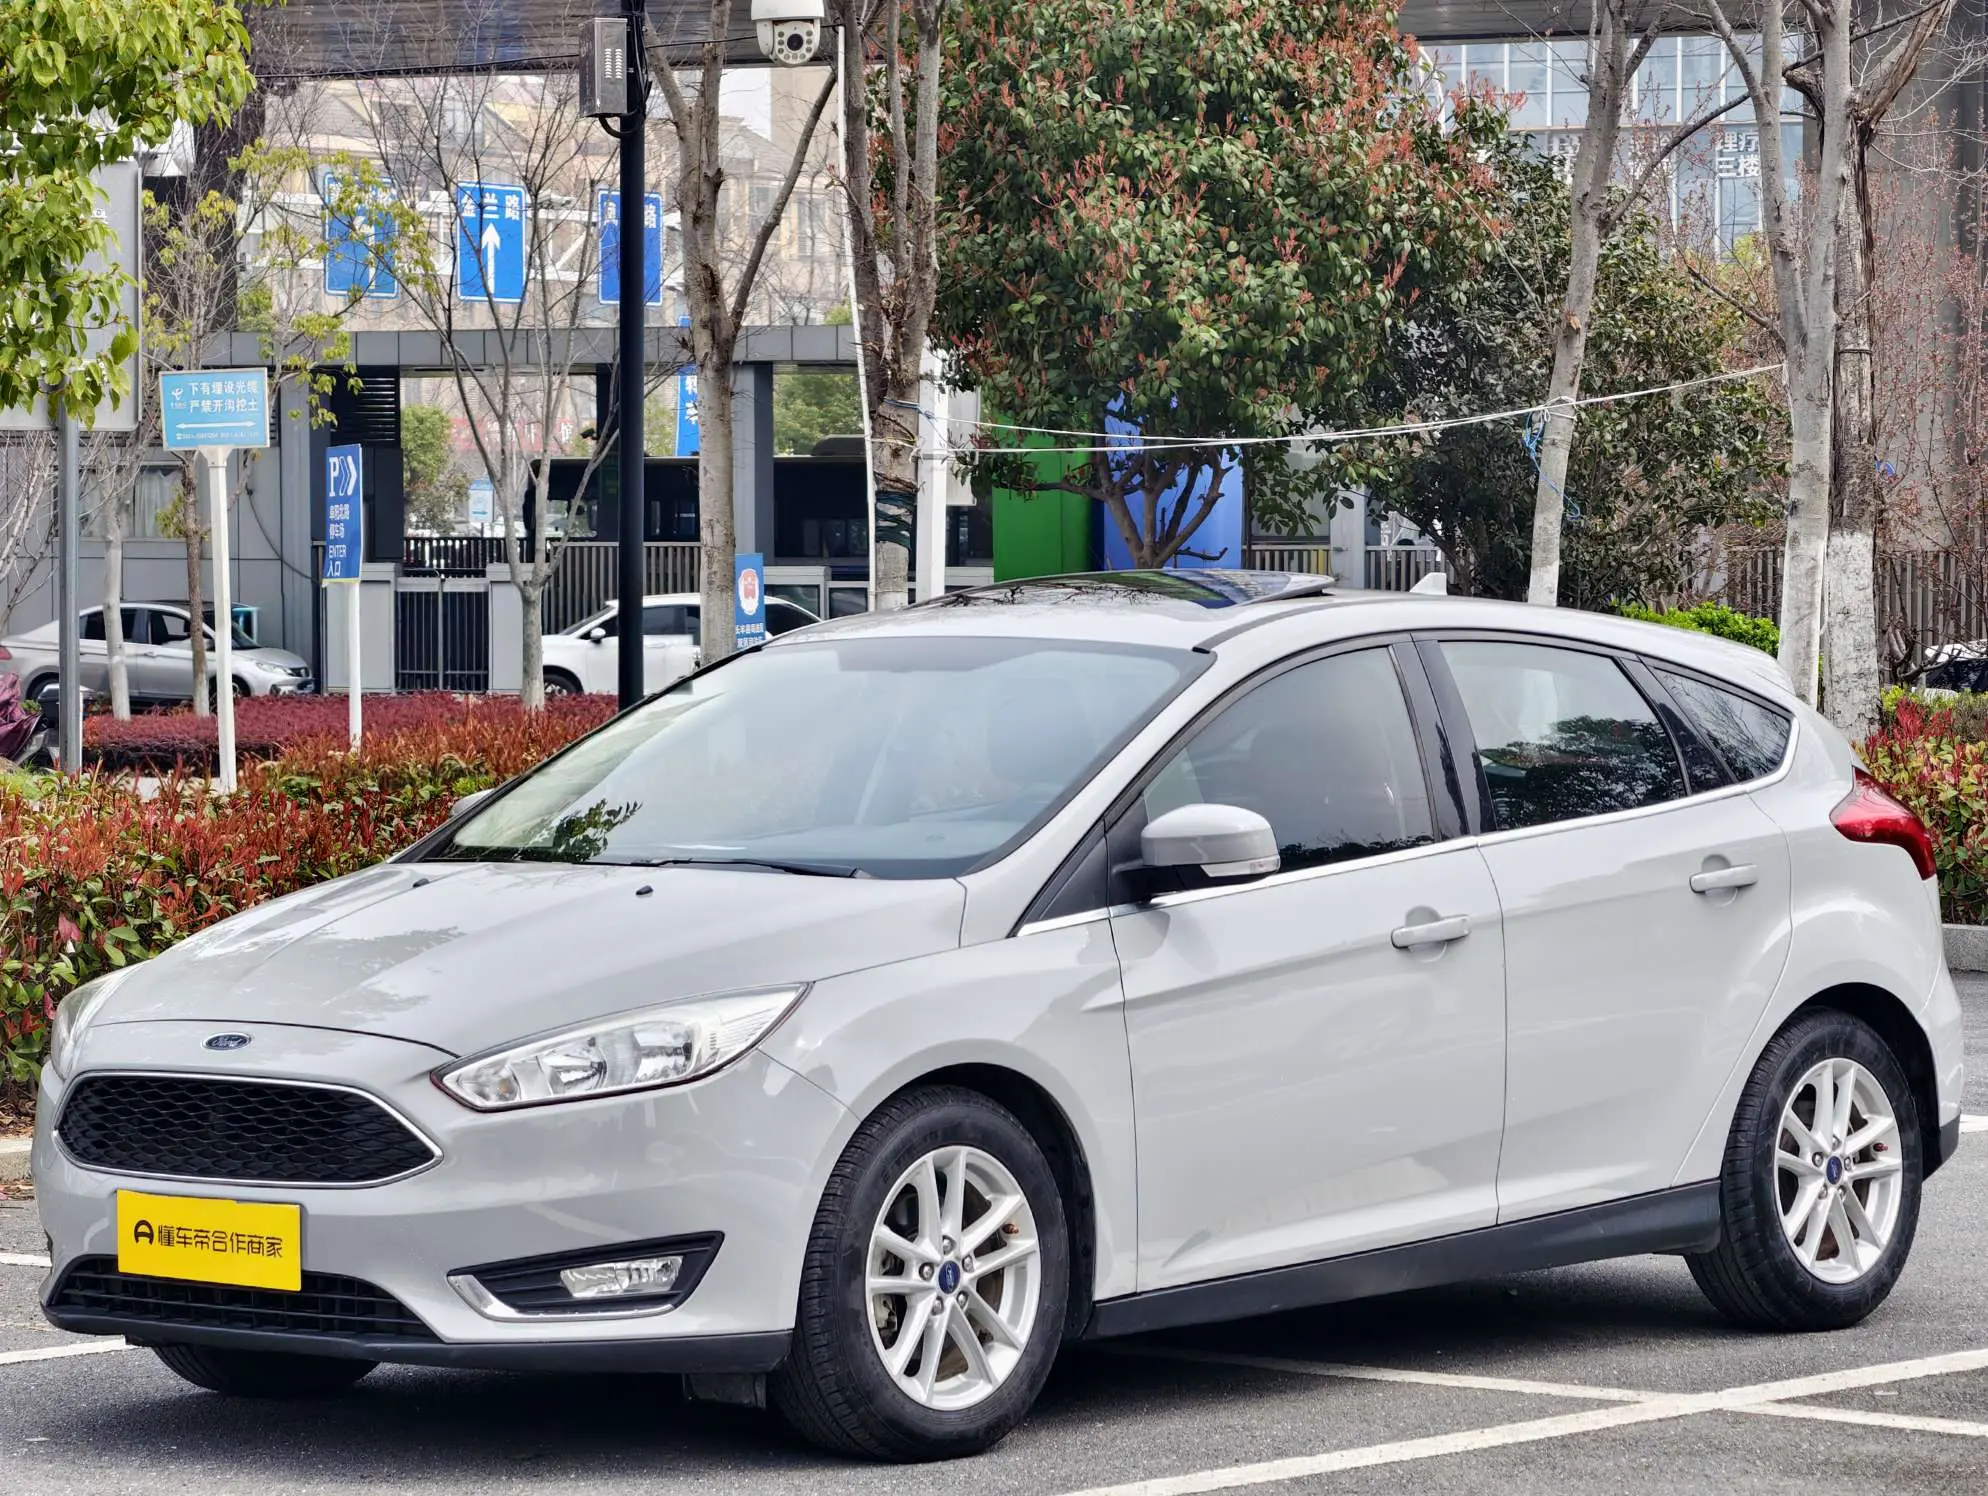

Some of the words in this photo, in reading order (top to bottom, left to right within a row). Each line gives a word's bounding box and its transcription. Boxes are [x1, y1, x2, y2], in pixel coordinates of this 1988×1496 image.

[1718, 154, 1760, 176] 三楼
[461, 190, 520, 221] 金兰路
[188, 380, 259, 396] 下有埋设光缆
[190, 399, 259, 413] 严禁开沟挖土
[329, 457, 339, 497] P
[328, 544, 347, 558] ENTER
[327, 560, 341, 577] 入口
[158, 1224, 283, 1258] 懂车帝合作商家
